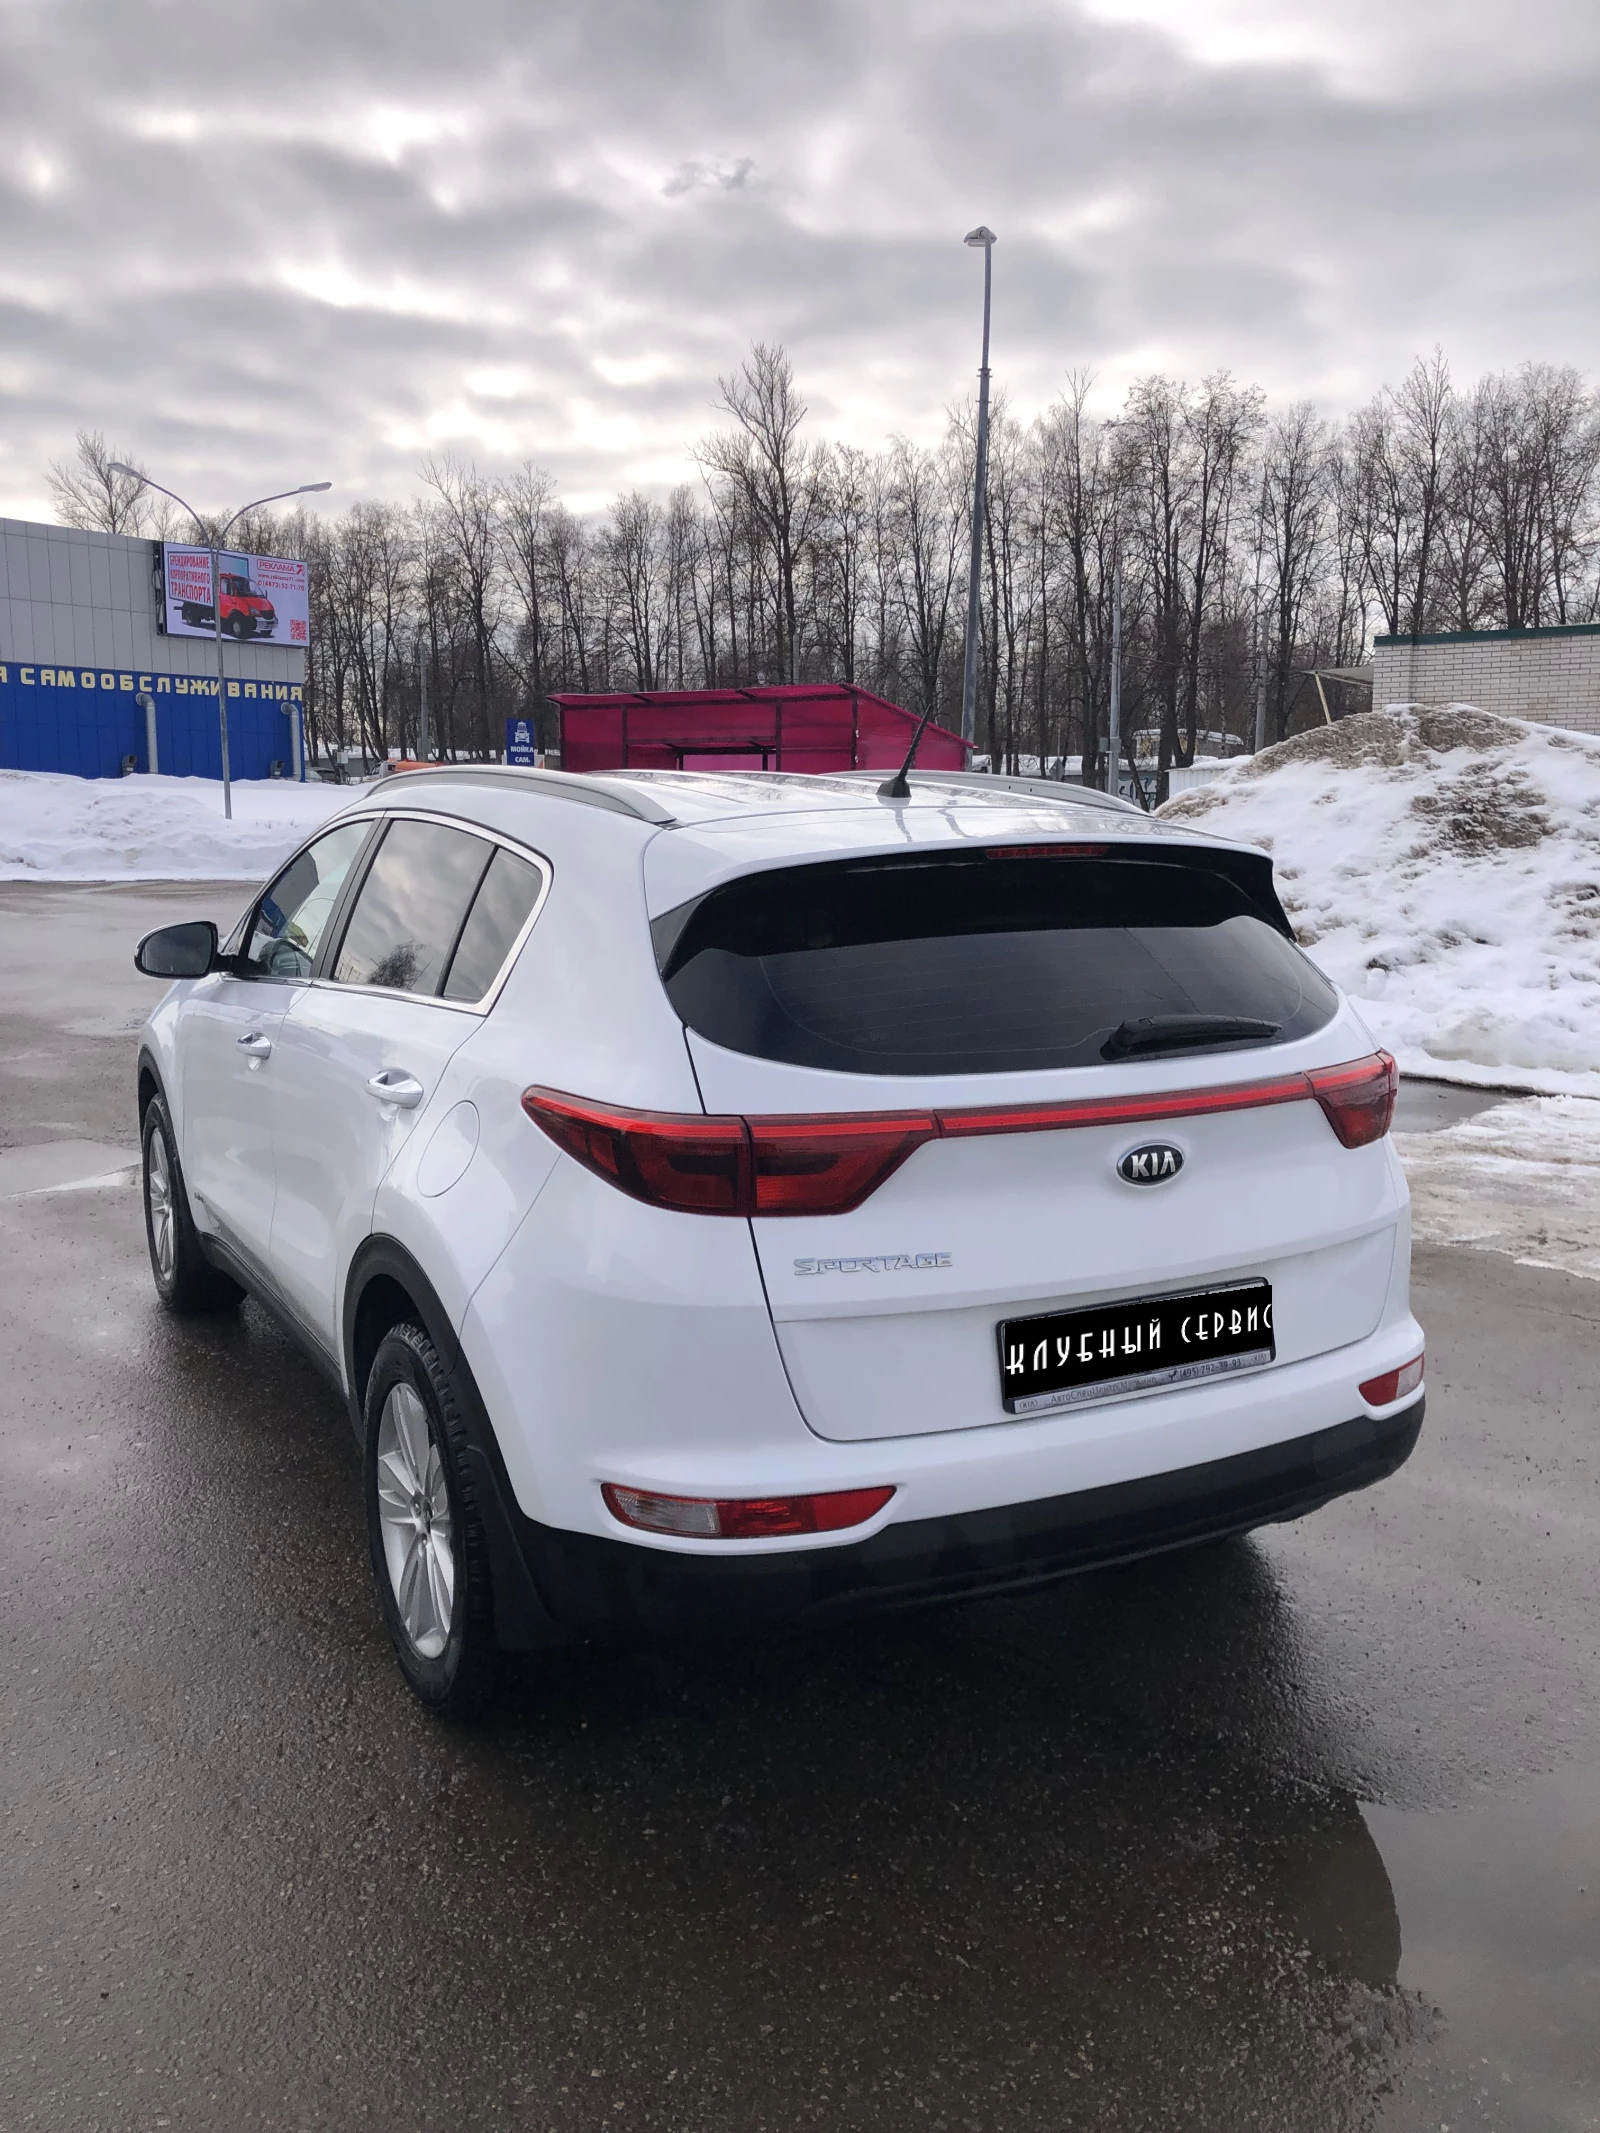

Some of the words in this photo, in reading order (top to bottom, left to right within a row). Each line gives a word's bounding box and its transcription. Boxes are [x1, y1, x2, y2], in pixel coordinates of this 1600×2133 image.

[169, 555, 209, 569] БРЕНДИРОВАНИЕ
[259, 561, 294, 573] РЕКЛАМА
[170, 569, 211, 584] КОРПОРАТИВНОГО
[170, 581, 211, 604] ТРАНСПОРТА
[20, 667, 302, 702] САМООБСЛУЖИВАНИЯ
[510, 745, 534, 753] МОЙКА
[1130, 1150, 1176, 1178] KIA
[793, 1251, 954, 1276] SPORTAGE
